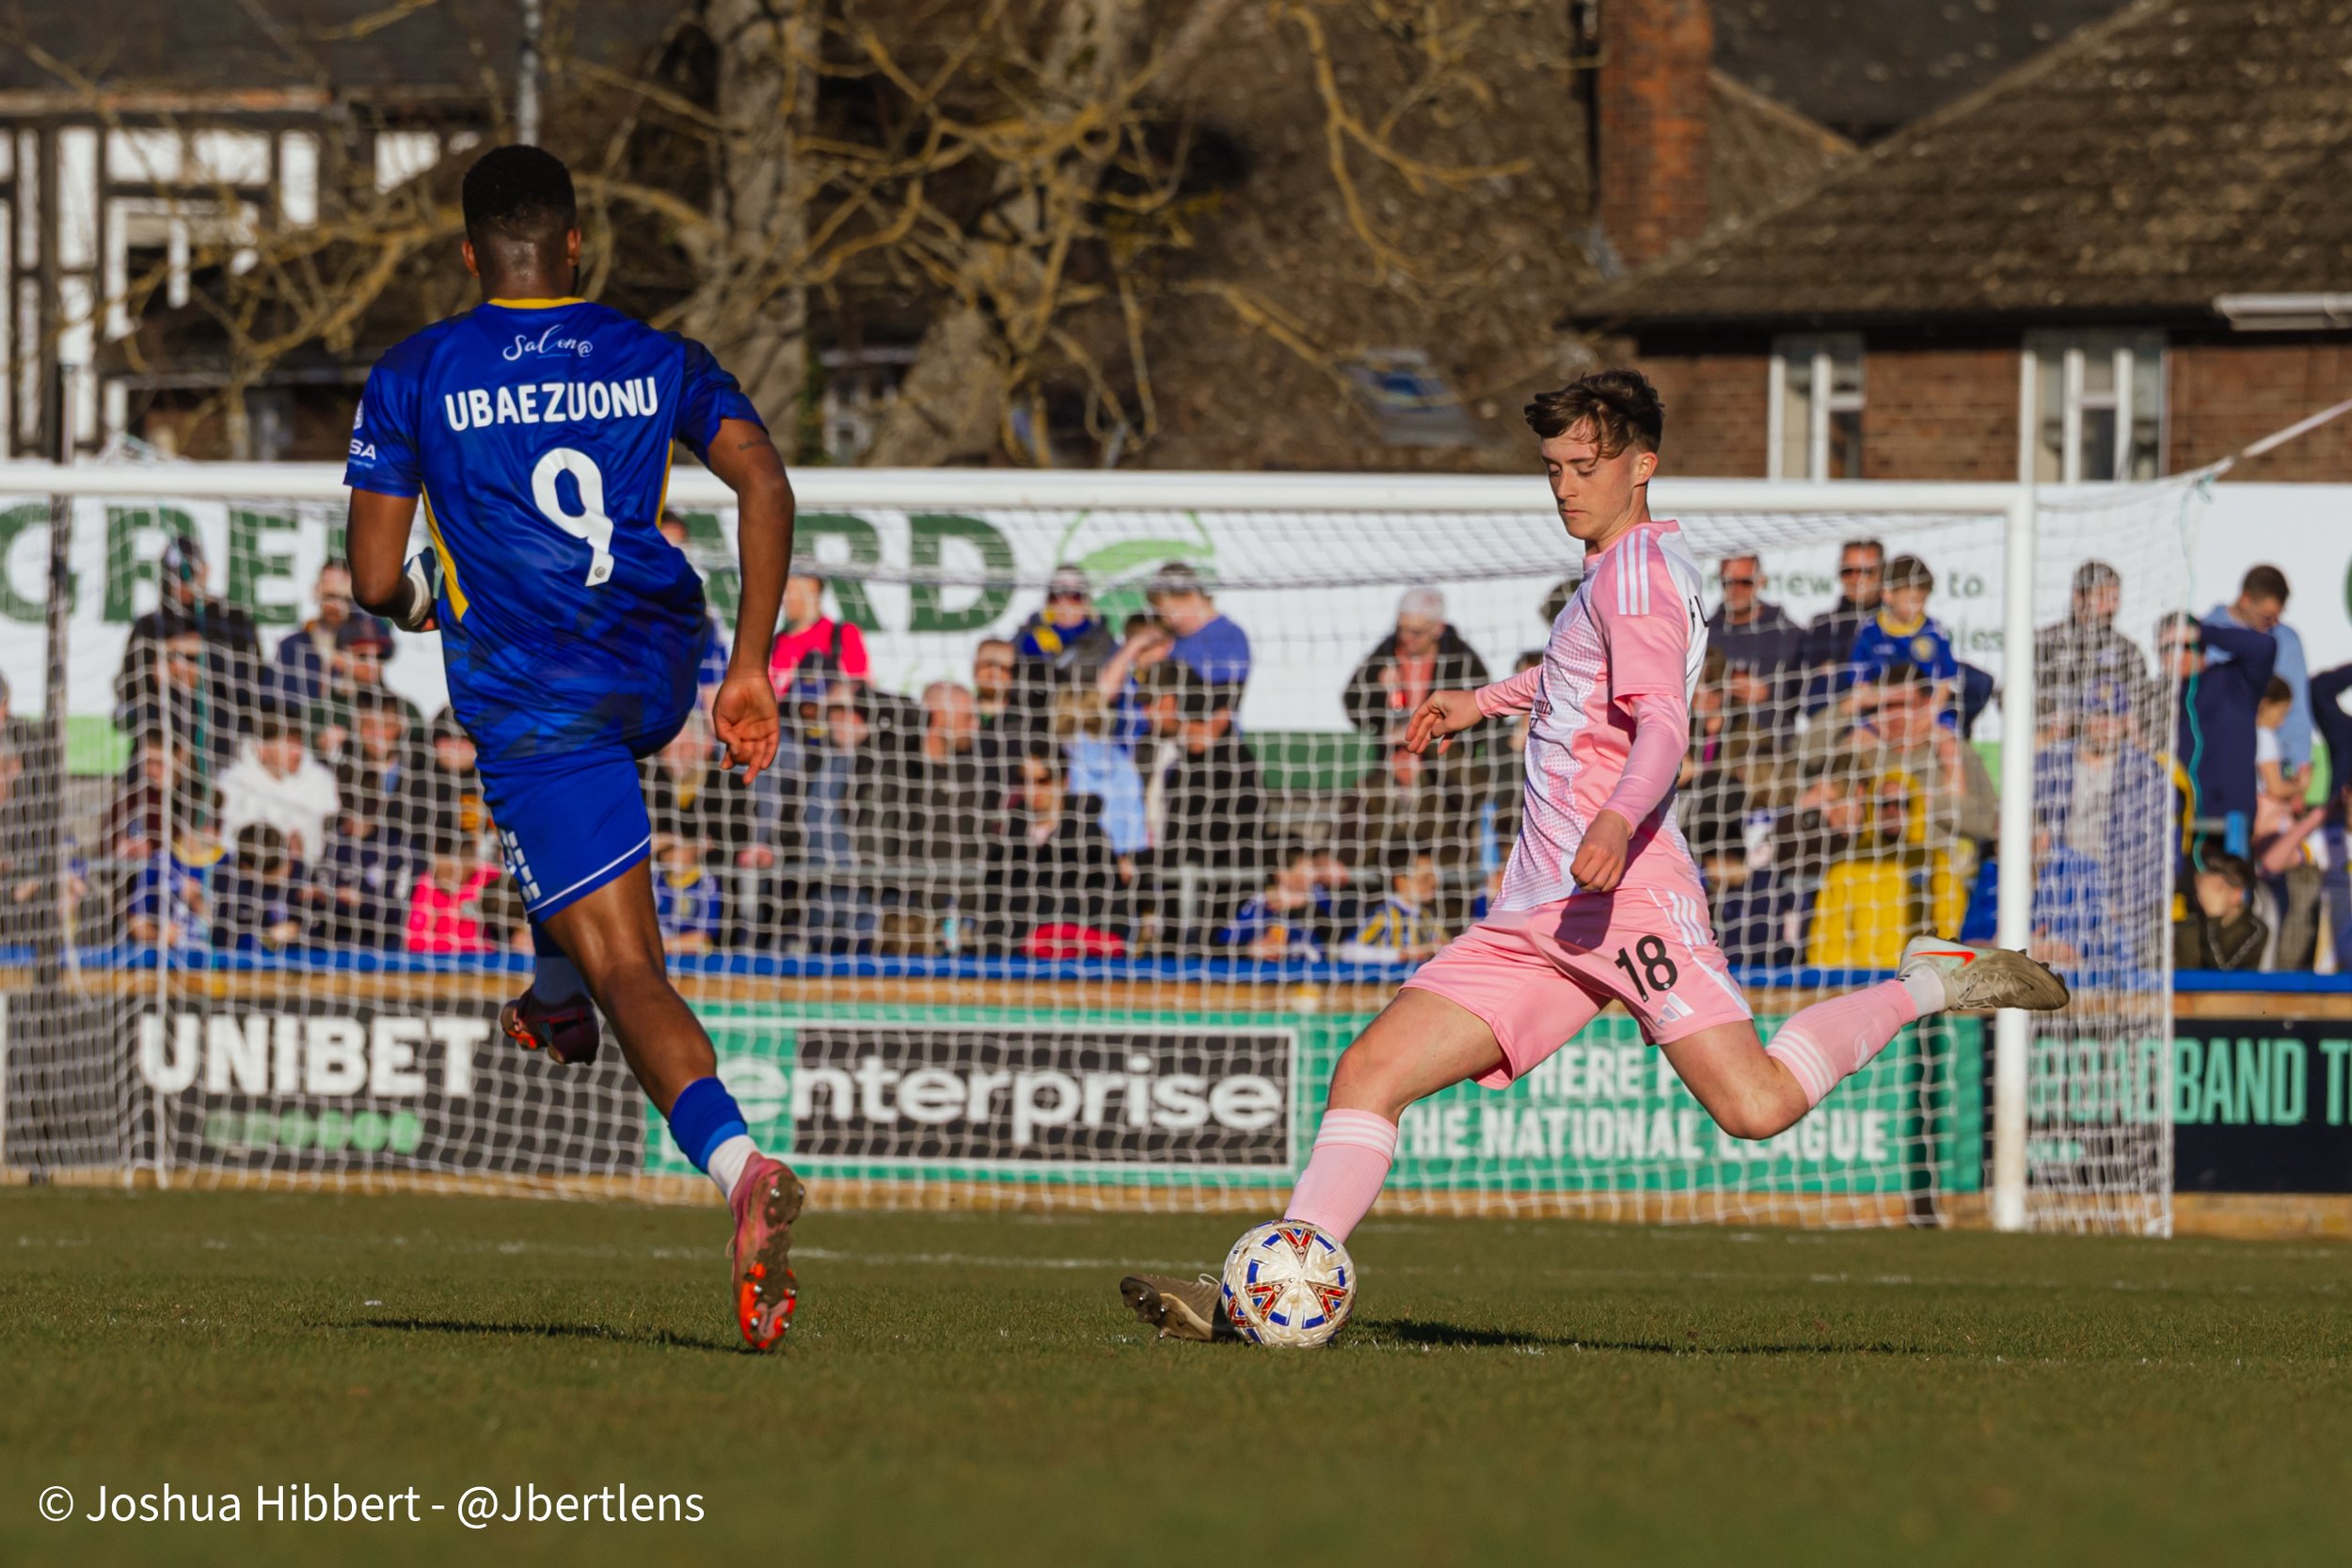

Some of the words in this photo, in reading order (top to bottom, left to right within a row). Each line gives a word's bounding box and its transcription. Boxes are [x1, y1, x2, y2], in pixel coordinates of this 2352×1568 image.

[445, 376, 658, 432] UBAEZUONU
[532, 448, 614, 587] 9
[1614, 935, 1677, 1003] 18
[138, 1014, 491, 1097] UNIBET
[715, 1053, 1283, 1147] enterprise
[1482, 1105, 1705, 1161] NATIONAL
